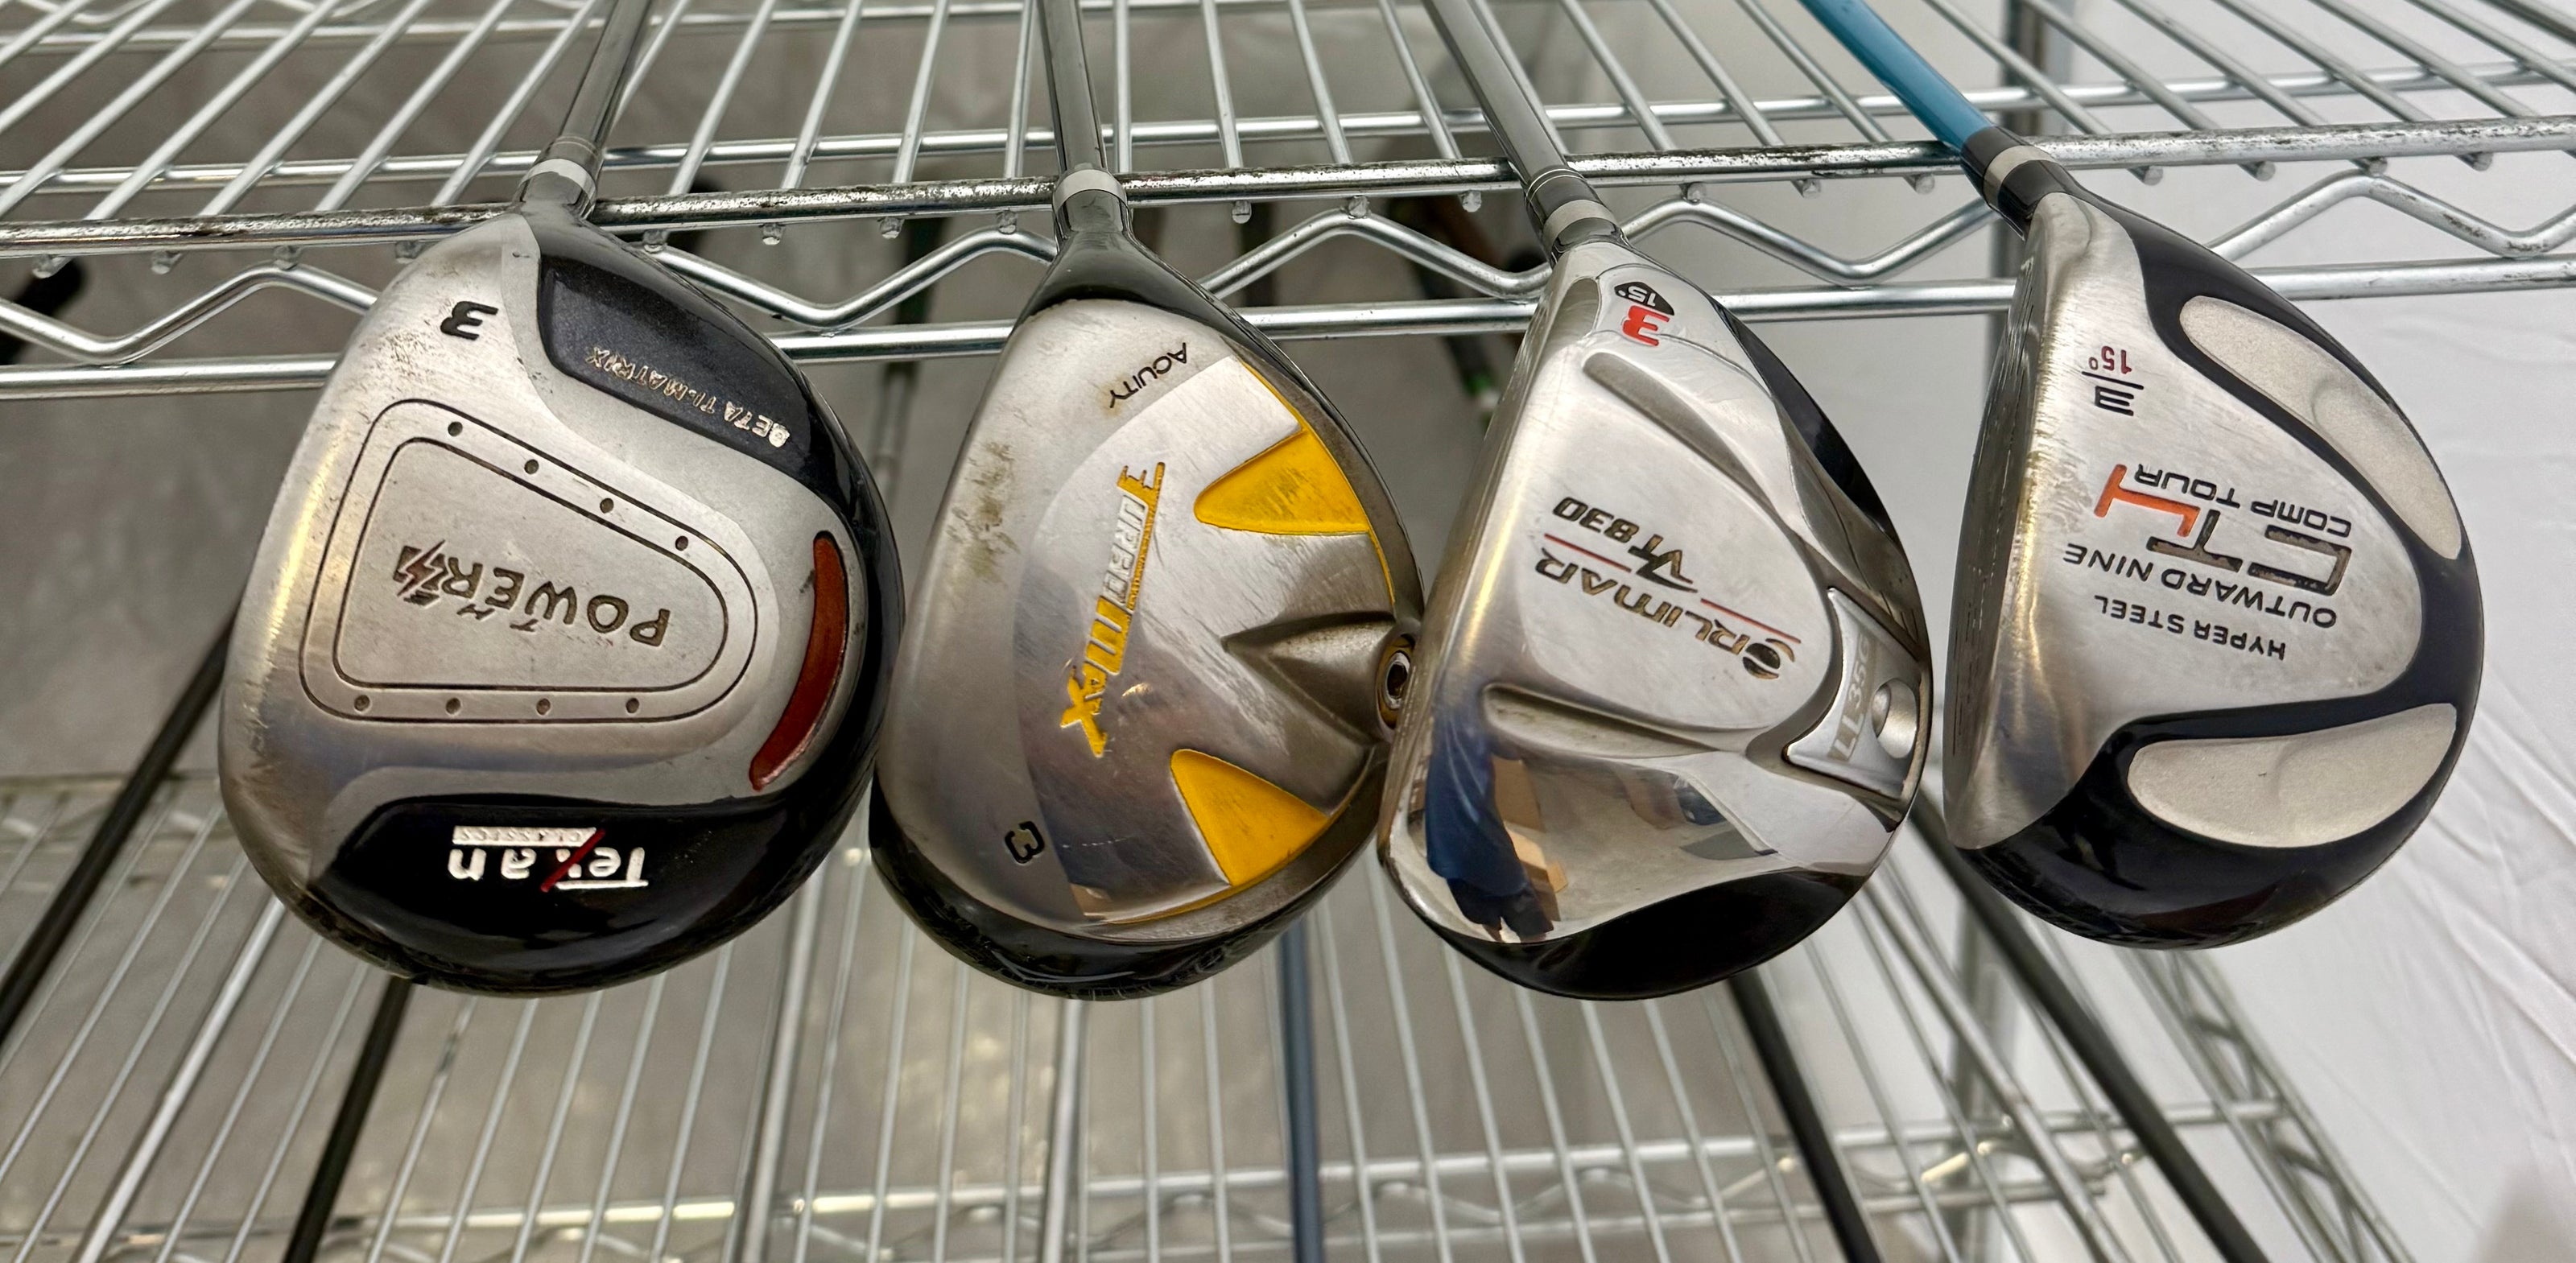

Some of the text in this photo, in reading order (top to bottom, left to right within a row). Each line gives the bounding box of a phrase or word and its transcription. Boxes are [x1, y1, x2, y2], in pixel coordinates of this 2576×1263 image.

[440, 300, 498, 341] 3
[1621, 303, 1670, 348] 3
[1108, 341, 1188, 408] ACUITY
[2087, 345, 2132, 374] 15°
[724, 400, 792, 448] BETA
[2094, 385, 2135, 416] 3
[2133, 463, 2352, 539] COMP TOUR
[2061, 542, 2339, 629] OUTWARD NINE
[1534, 547, 1797, 680] ORLIMAR
[2094, 594, 2288, 662] HYPER STEEL
[1003, 819, 1045, 864] 3
